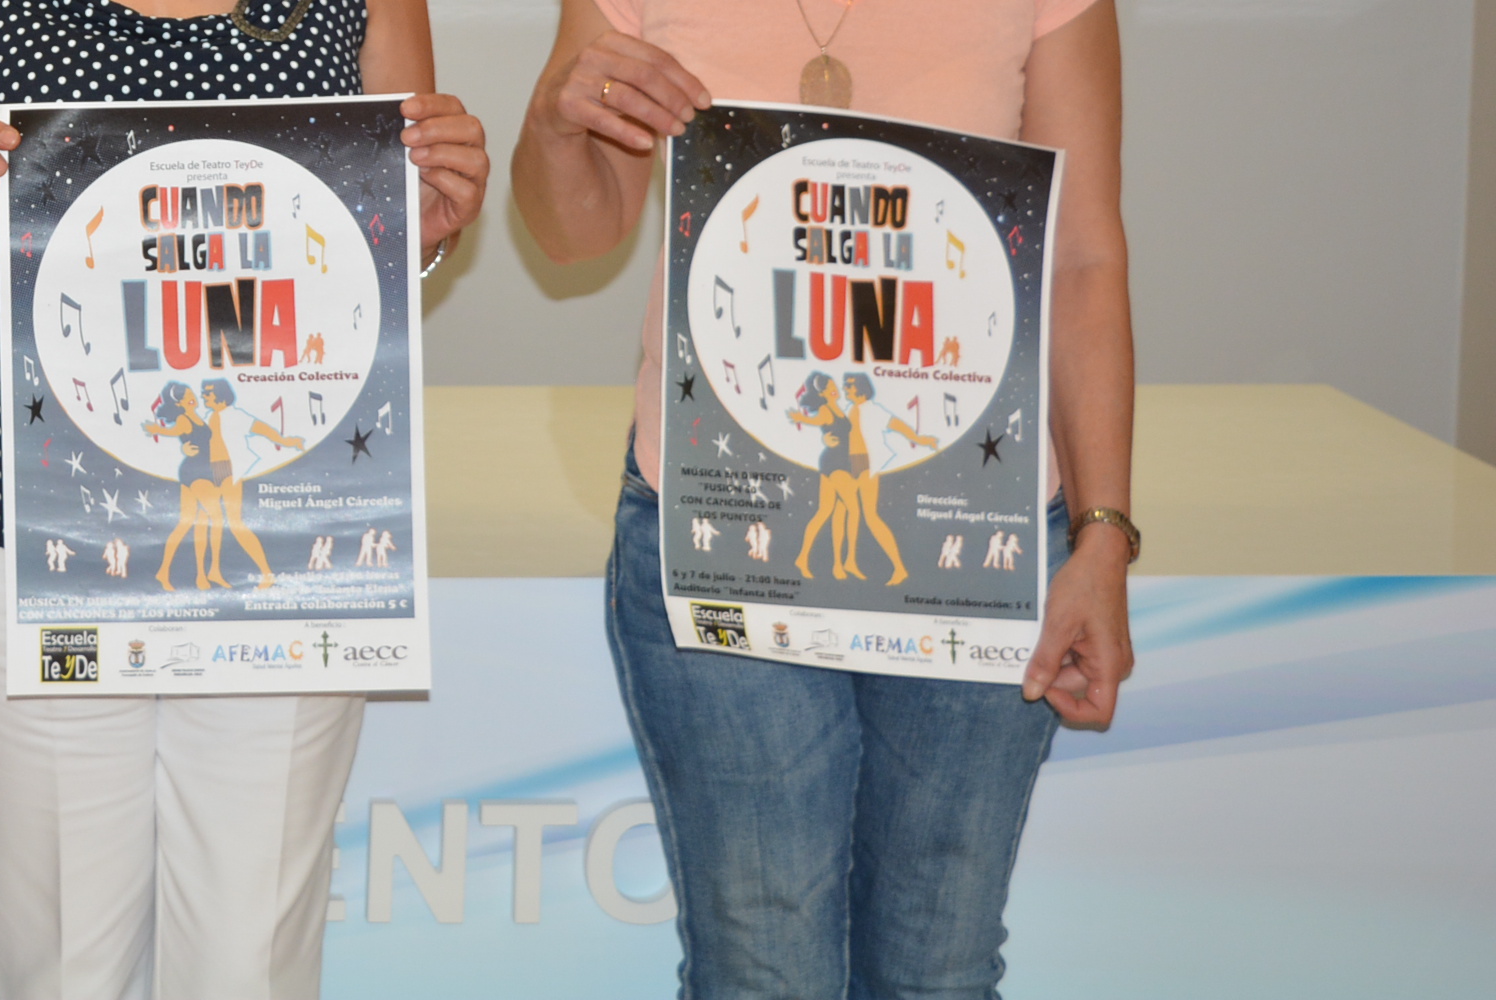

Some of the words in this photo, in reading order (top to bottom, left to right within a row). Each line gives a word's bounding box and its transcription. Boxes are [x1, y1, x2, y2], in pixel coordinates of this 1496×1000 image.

[149, 160, 185, 172] Escuela
[187, 159, 199, 171] de
[201, 159, 231, 170] Teatro
[233, 158, 264, 173] TeyDe
[802, 156, 836, 169] Escuela
[837, 158, 849, 169] de
[851, 159, 880, 170] Teatro
[186, 171, 228, 183] presenta
[836, 171, 876, 183] presenta
[139, 182, 264, 231] CUANDO
[792, 178, 910, 230] CUANDO
[142, 231, 225, 273] SALGA
[238, 230, 272, 271] LA
[792, 226, 871, 266] SALGA
[882, 232, 913, 271] LA
[121, 276, 298, 372] LUNA
[772, 267, 935, 368] LUNA
[237, 372, 295, 383] Creación
[299, 371, 359, 381] Colectiva
[873, 366, 929, 381] Creación
[932, 369, 992, 384] Colectiva
[258, 482, 321, 494] Dirección
[258, 498, 302, 509] Miguel
[305, 495, 343, 509] Ángel
[346, 496, 403, 506] Cárceles
[244, 600, 297, 611] Entrada
[301, 598, 385, 610] colaboración
[692, 605, 743, 623] Escuela
[42, 630, 97, 646] Escuela
[850, 634, 934, 655] AFEMAC
[212, 640, 304, 662] AFEMAC
[343, 644, 408, 661] aecc
[969, 643, 1030, 662] aecc
